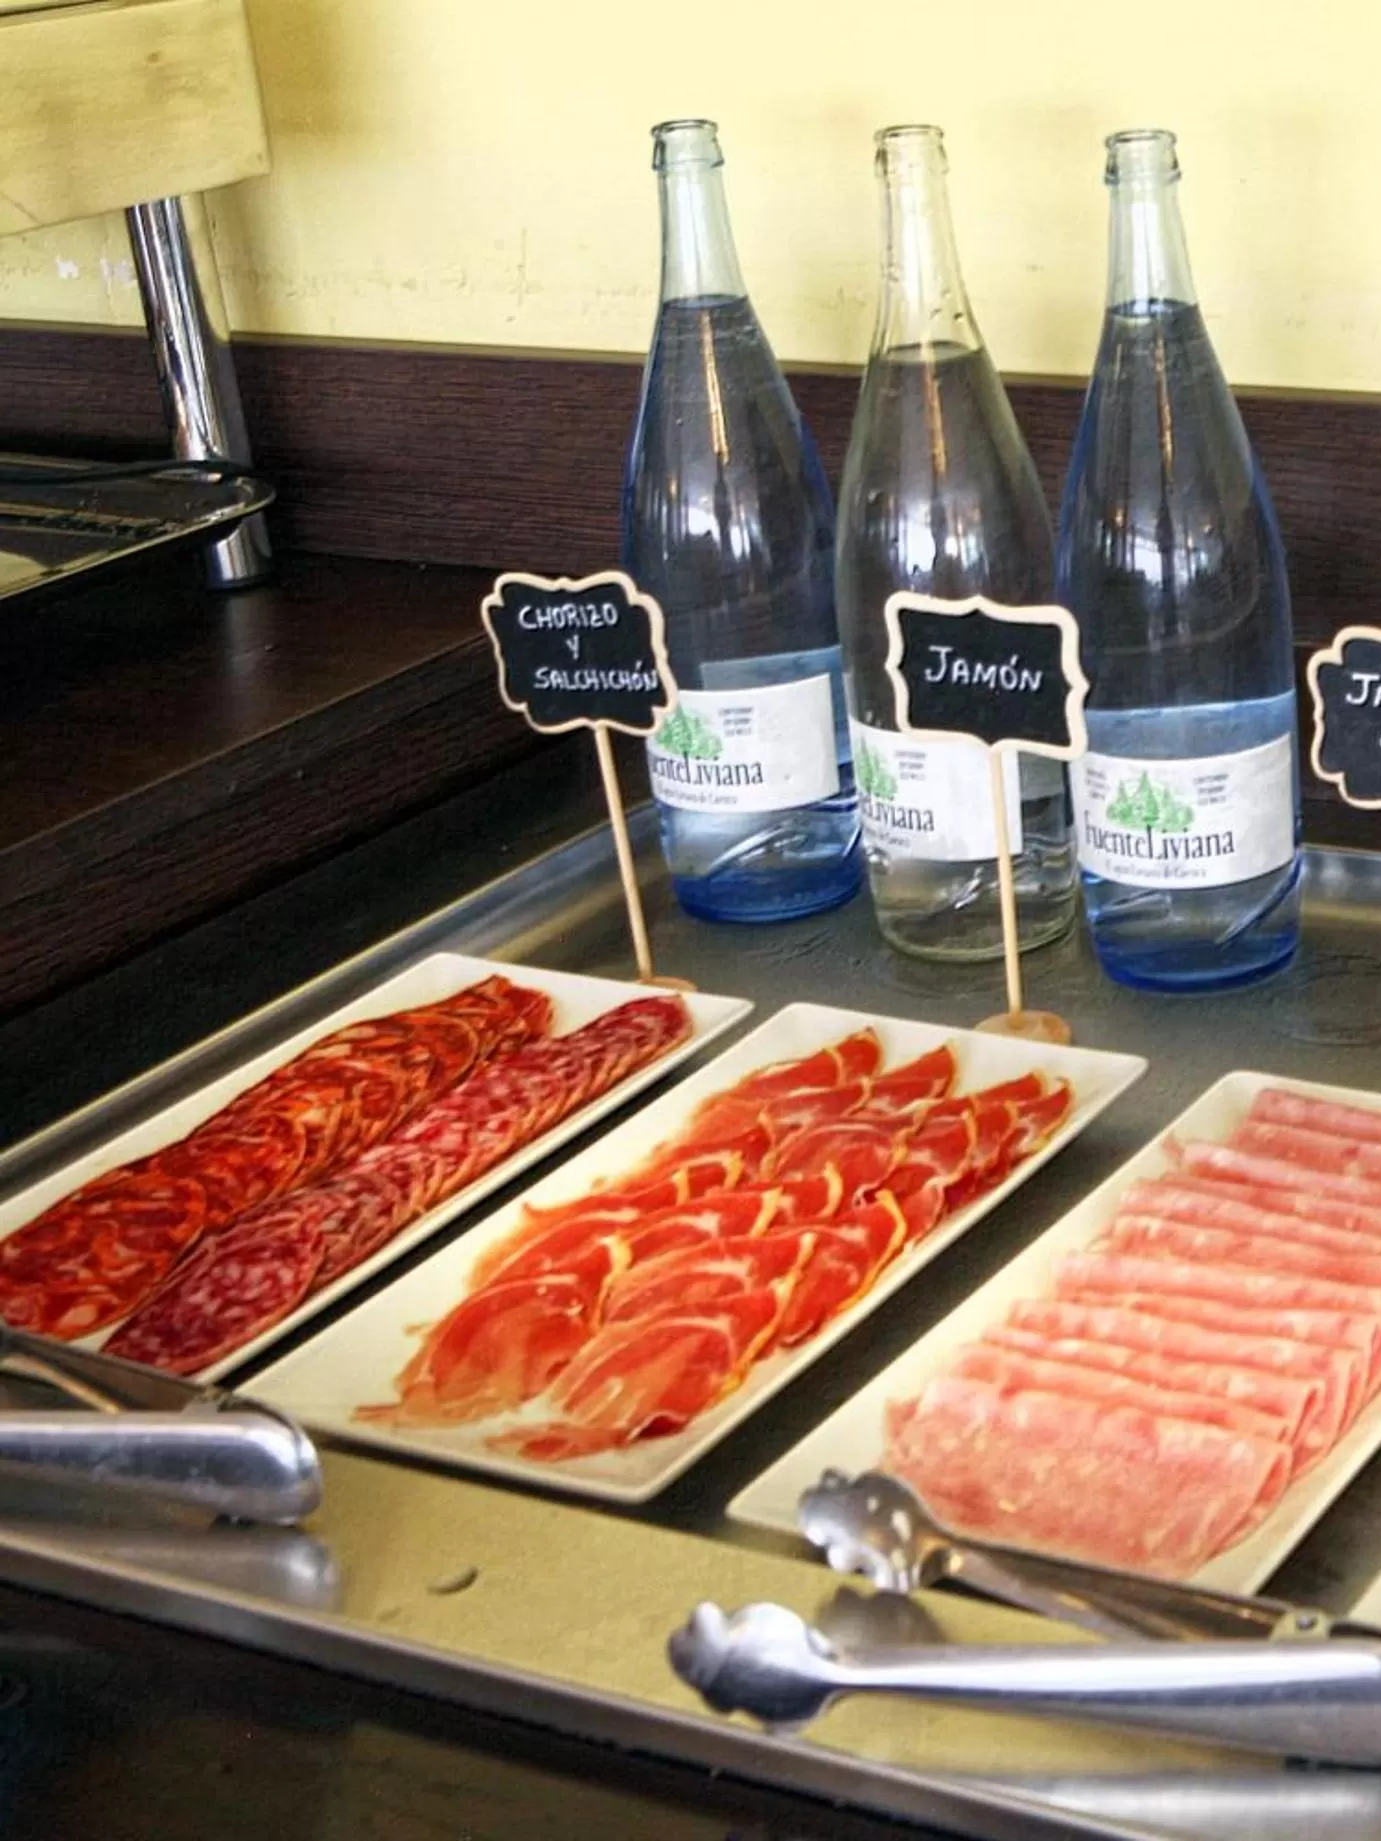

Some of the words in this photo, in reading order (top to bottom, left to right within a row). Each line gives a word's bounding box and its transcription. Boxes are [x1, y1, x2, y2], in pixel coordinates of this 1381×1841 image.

[518, 602, 619, 630] CHORIZO
[533, 660, 659, 691] SALCHICHÓN
[924, 645, 1043, 691] JAMÓN
